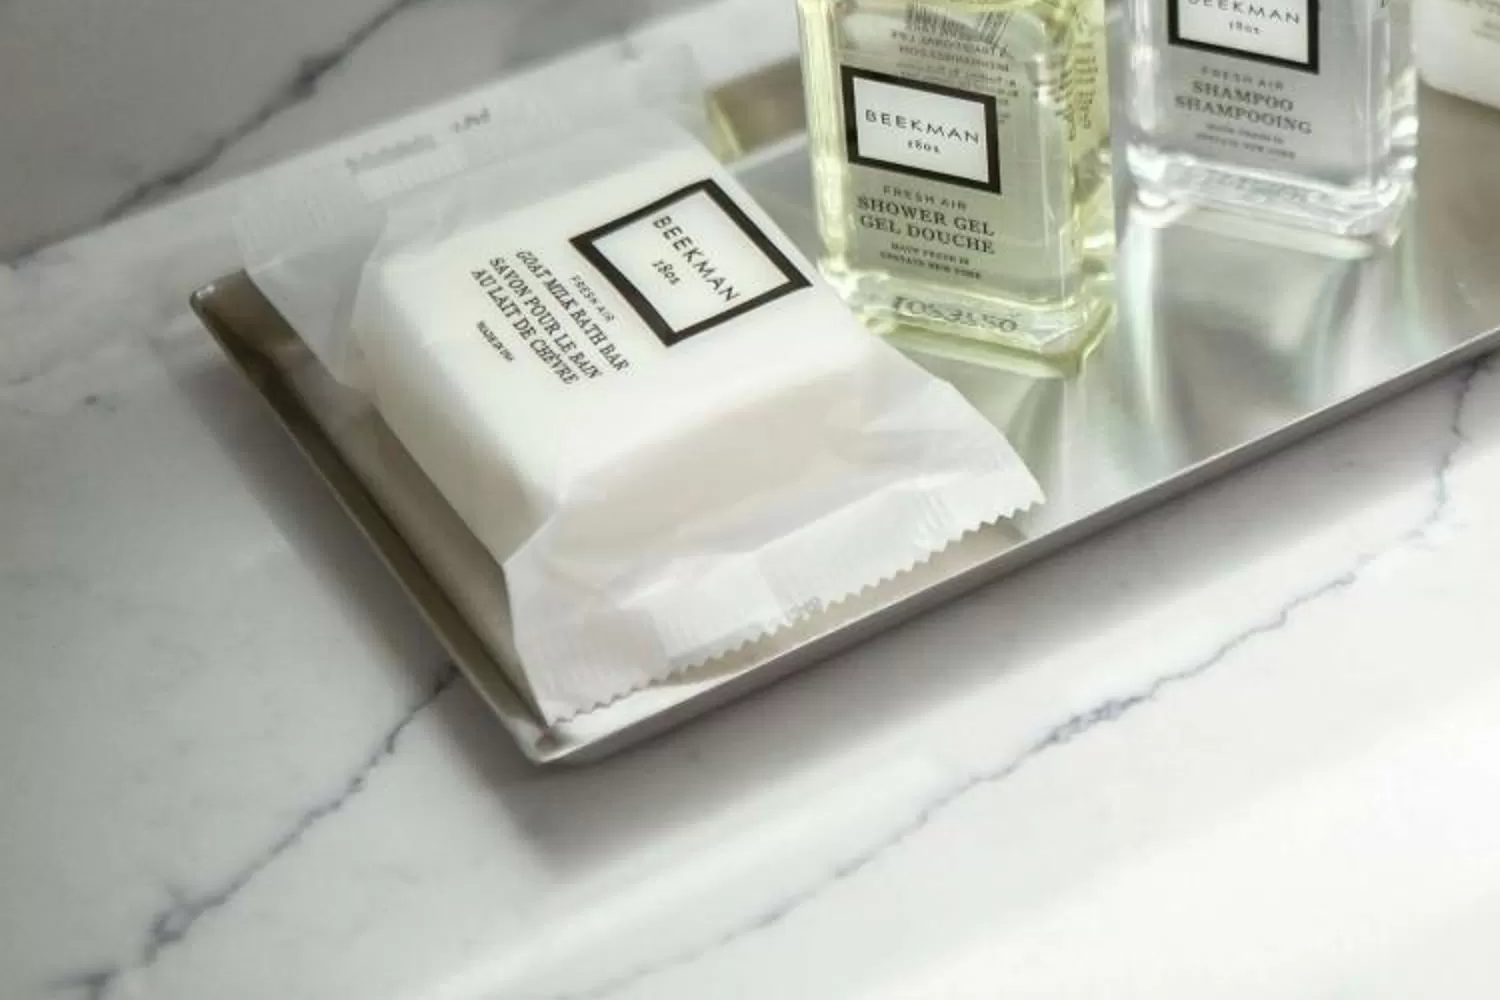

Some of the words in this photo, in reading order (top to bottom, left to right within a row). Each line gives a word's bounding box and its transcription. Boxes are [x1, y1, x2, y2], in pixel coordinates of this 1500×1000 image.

[1174, 95, 1312, 136] SHAMPOOING
[1192, 80, 1294, 113] SHAMPOO
[864, 108, 979, 145] BEEKMAN
[907, 139, 941, 154] 1802
[857, 195, 948, 227] SHOWER
[953, 216, 996, 237] GEL
[884, 185, 935, 205] FRESH
[940, 198, 967, 211] AIR
[860, 214, 900, 235] GEL
[907, 223, 996, 255] DOUCHE
[651, 258, 681, 287] 1802
[652, 214, 741, 303] BEEKMAN
[470, 268, 498, 288] AU
[486, 285, 522, 319] LAIT
[512, 315, 537, 341] DE
[489, 256, 533, 297] SAVON
[523, 295, 561, 336] POUR
[552, 332, 577, 354] LE
[567, 351, 605, 379] BAIN
[516, 250, 553, 279] GOAT
[541, 277, 579, 311] MILK
[568, 308, 609, 347] BATH
[599, 343, 630, 371] BAR
